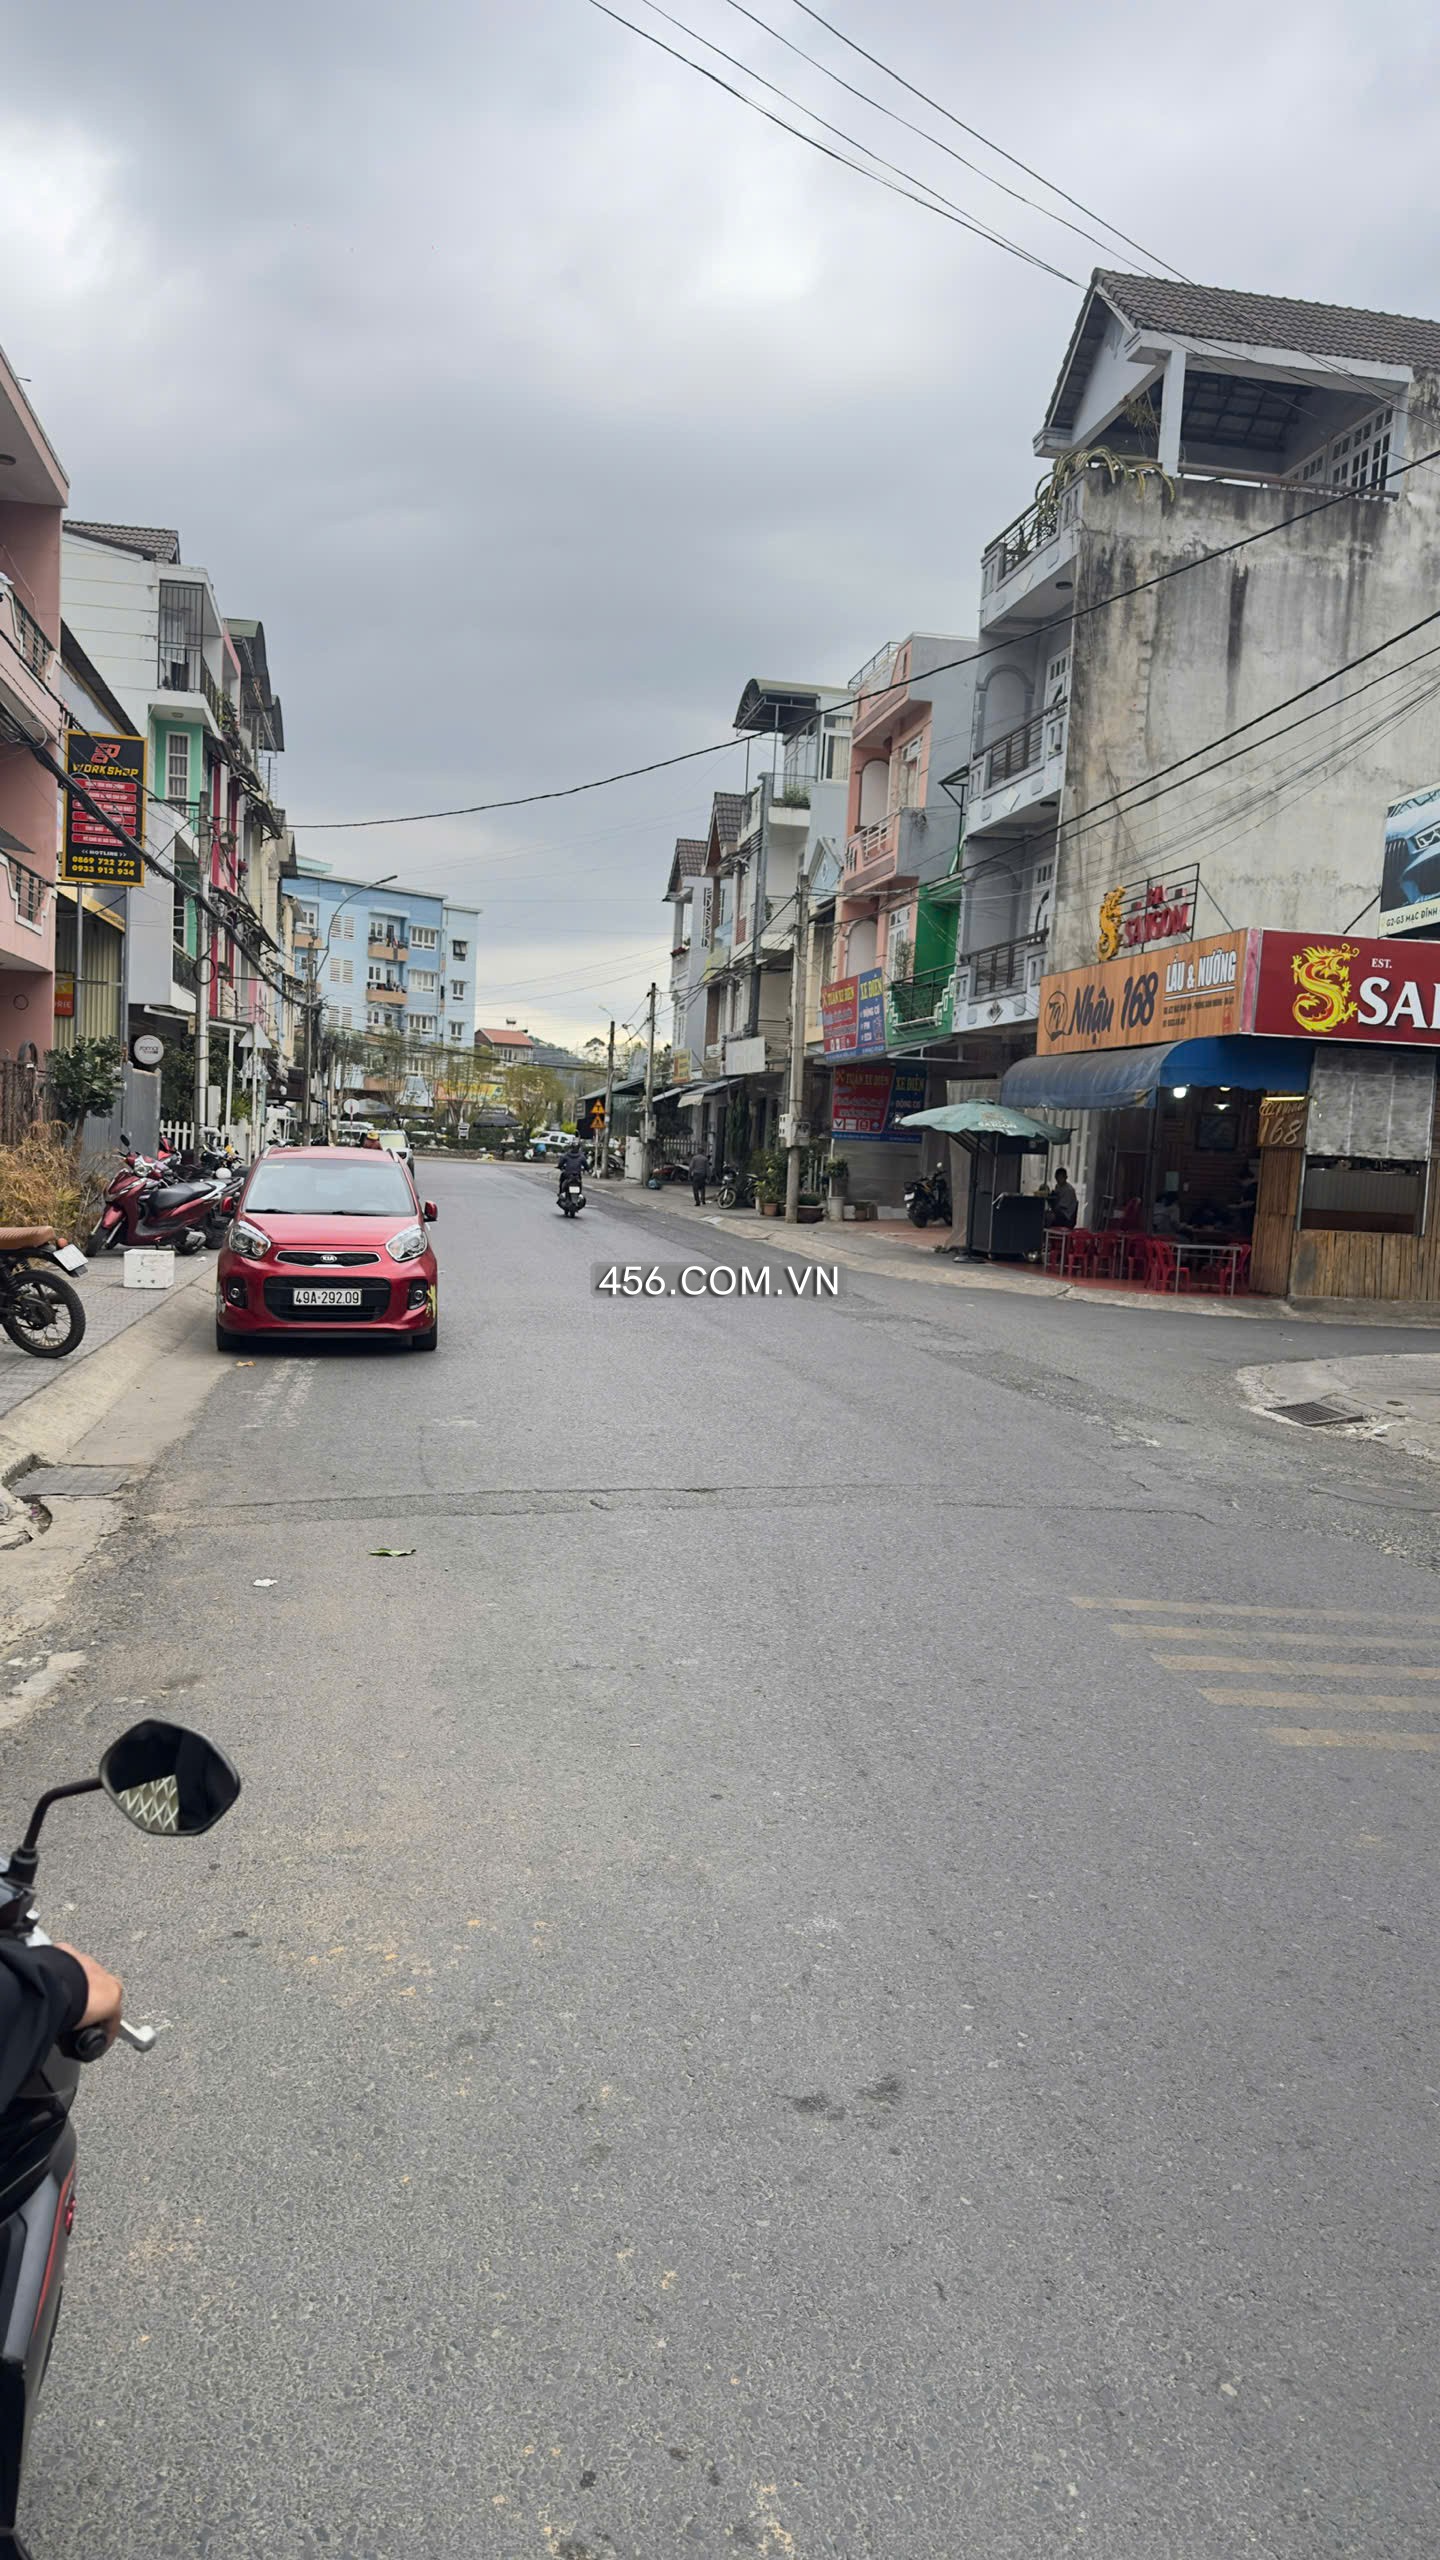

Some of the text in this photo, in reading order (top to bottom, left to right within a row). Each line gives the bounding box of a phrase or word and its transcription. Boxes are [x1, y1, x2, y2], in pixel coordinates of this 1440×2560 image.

[72, 764, 139, 777] WORKSHOP
[72, 856, 95, 864] 0869
[97, 858, 115, 866] 722
[72, 865, 135, 877] 0933 912 934
[1371, 958, 1392, 969] EST.
[1187, 963, 1195, 988] &
[1068, 971, 1159, 1044] Nhậu 168
[1260, 1117, 1304, 1145] 168
[295, 1291, 359, 1304] 49A-292.09
